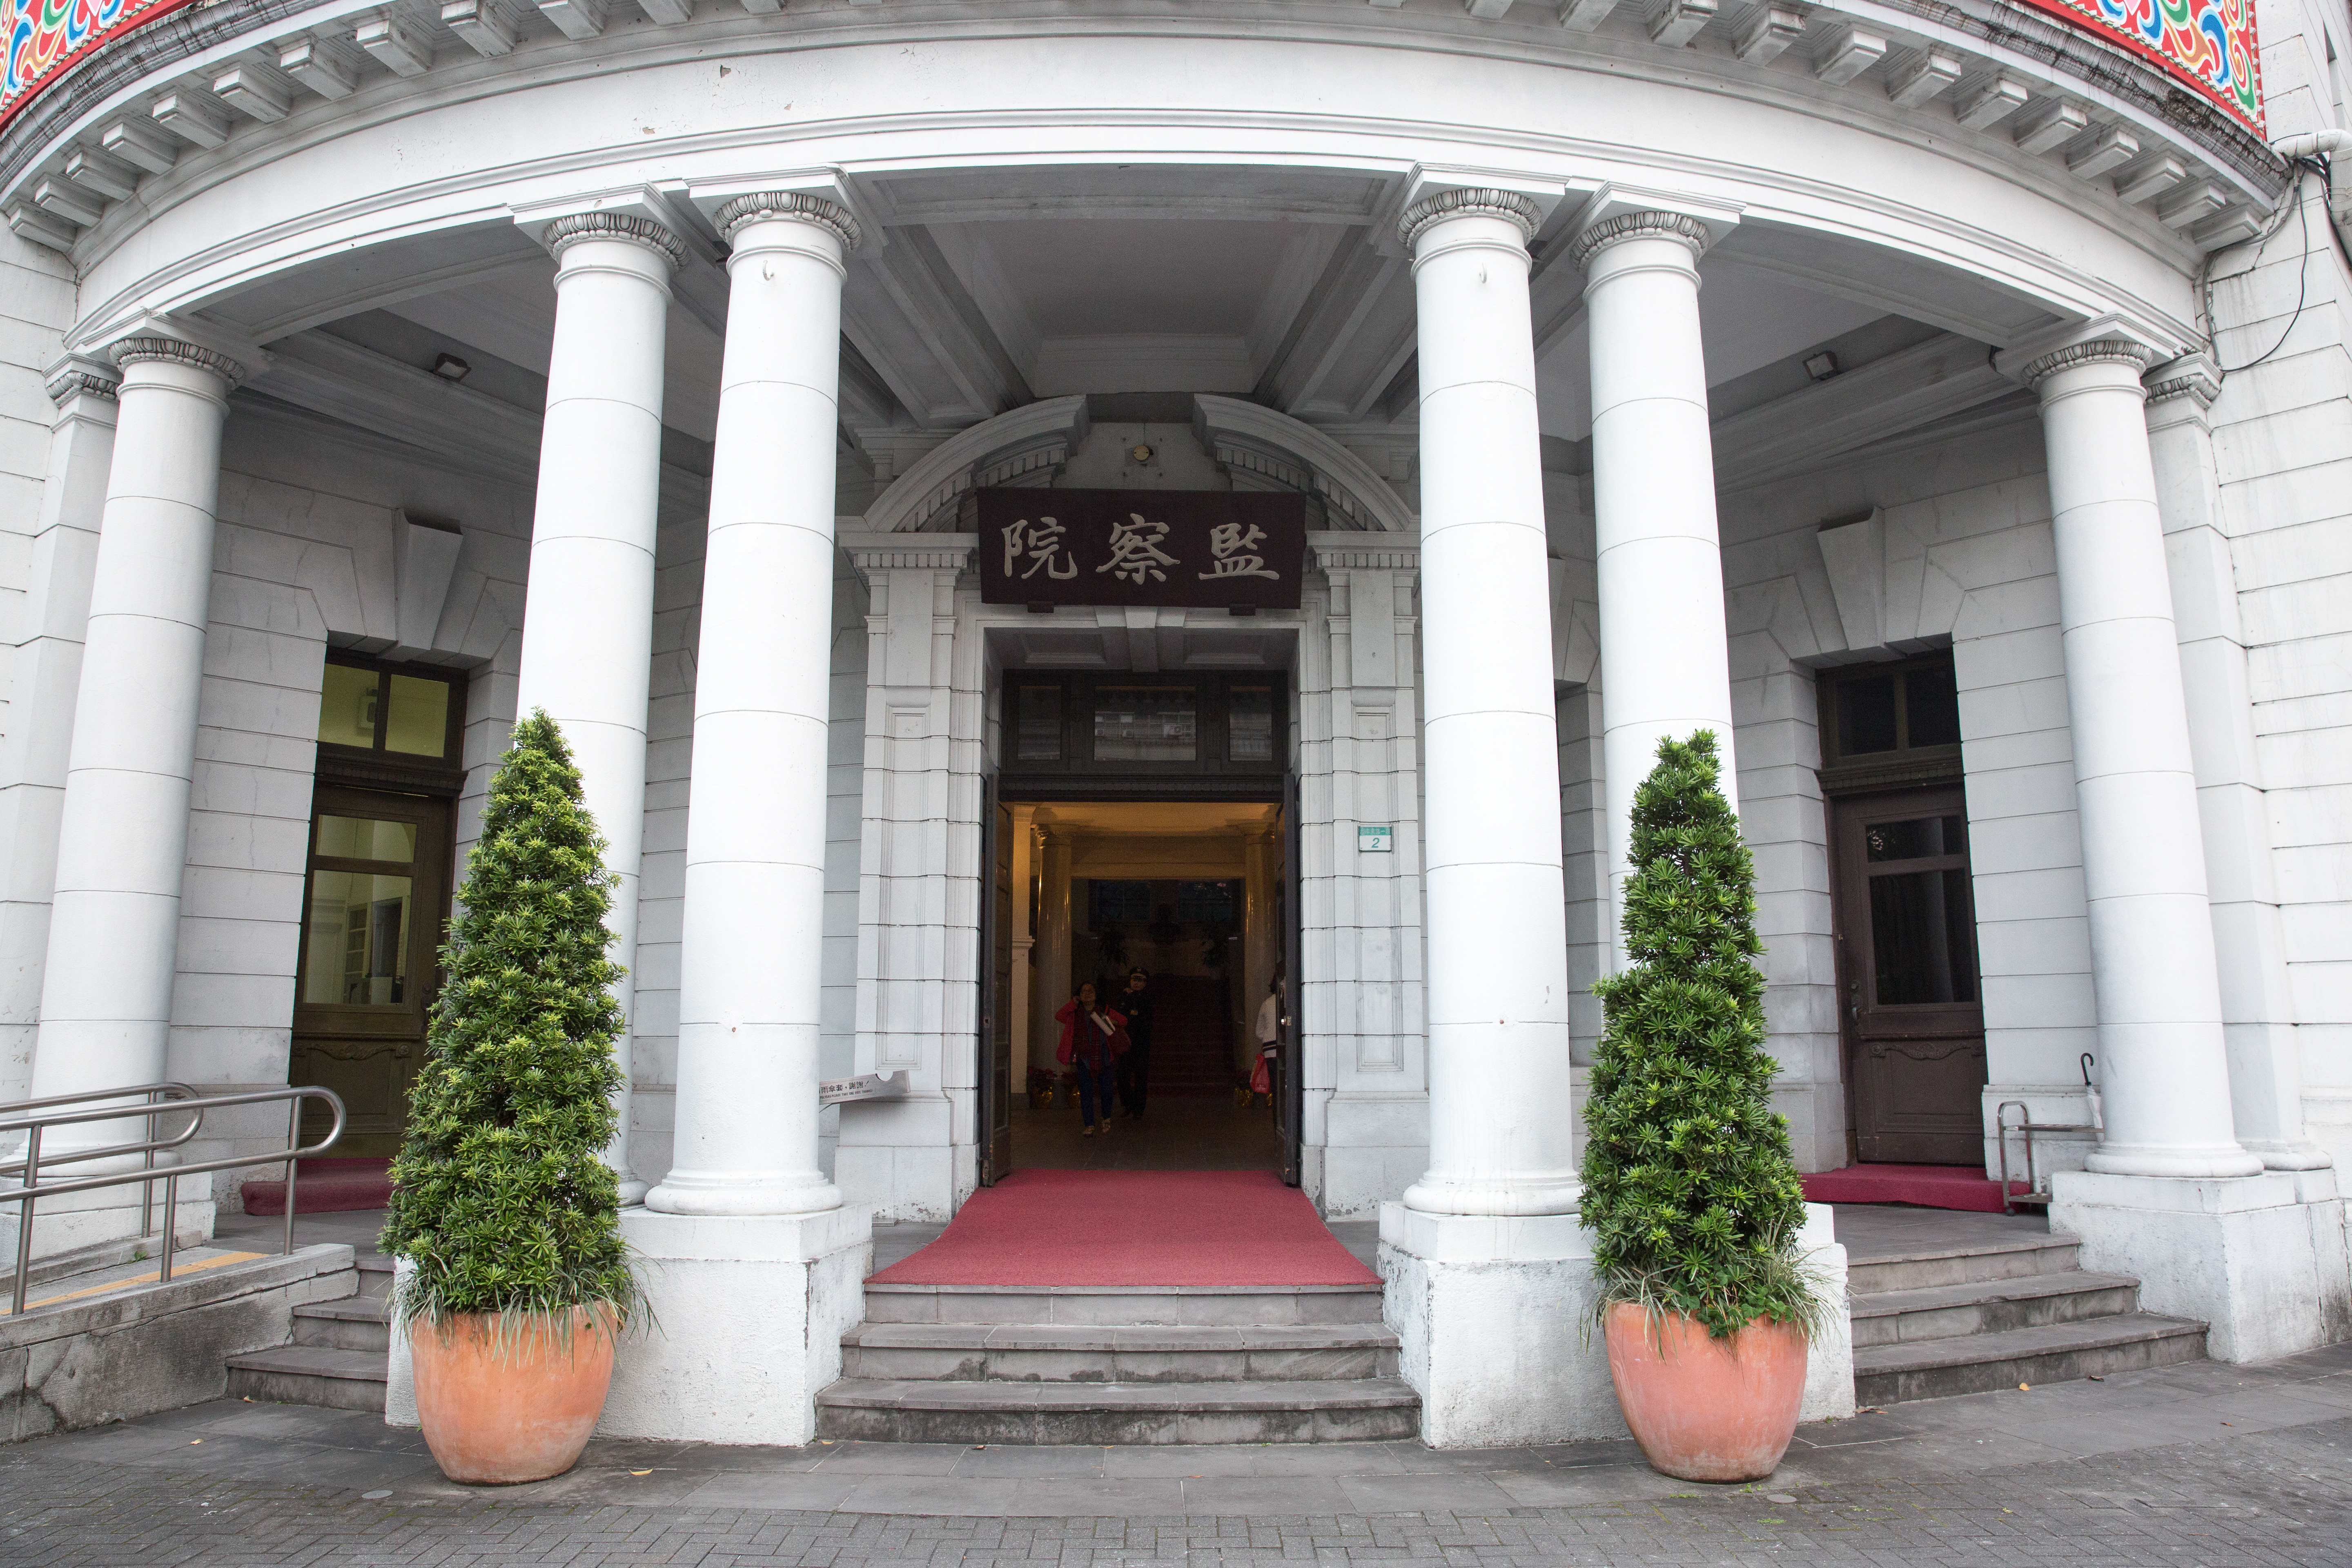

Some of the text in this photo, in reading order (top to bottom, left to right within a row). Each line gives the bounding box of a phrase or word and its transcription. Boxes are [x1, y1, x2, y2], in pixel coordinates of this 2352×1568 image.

[1371, 837, 1380, 848] 2
[819, 1080, 869, 1094] 雨傘套，謝謝！
